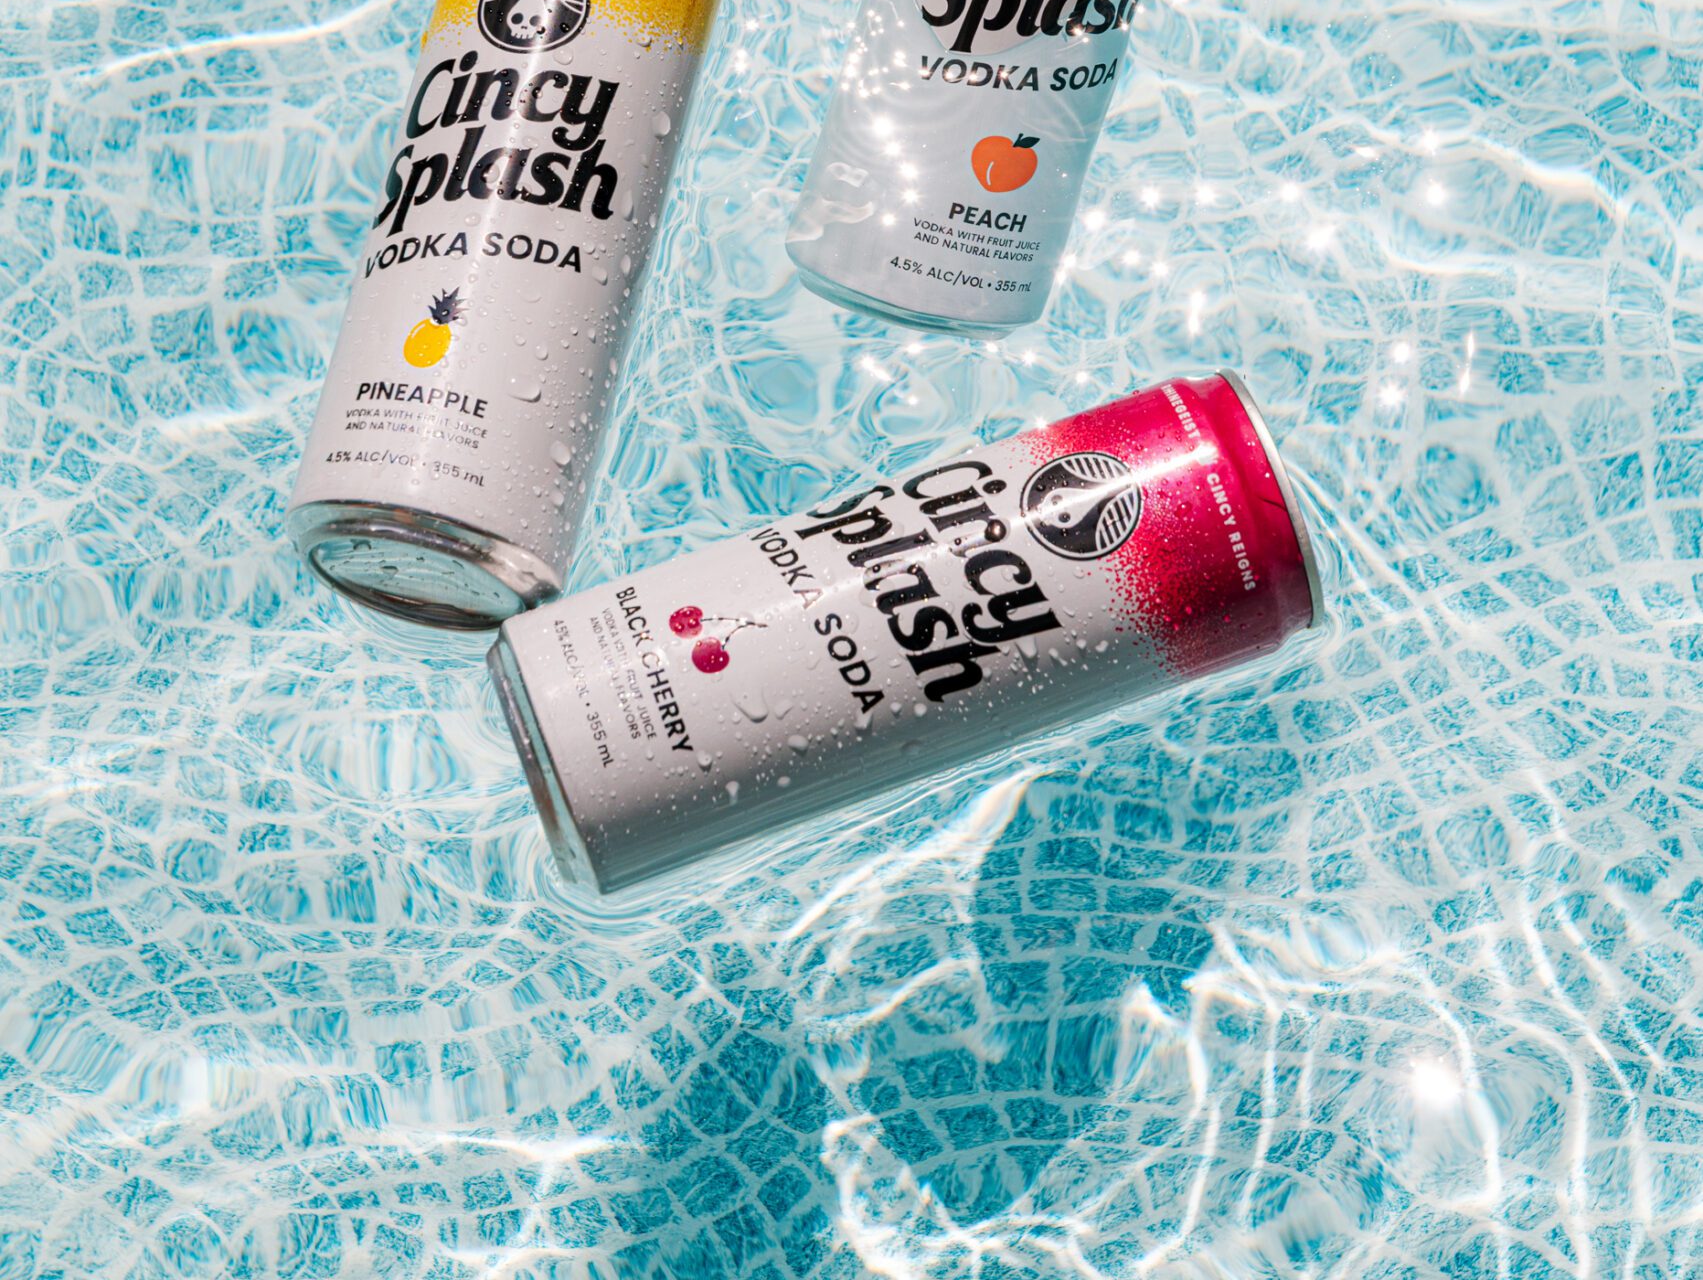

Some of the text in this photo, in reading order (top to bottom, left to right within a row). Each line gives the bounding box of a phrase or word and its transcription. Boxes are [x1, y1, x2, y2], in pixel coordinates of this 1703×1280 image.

[920, 55, 1118, 92] VODKA SODA
[406, 50, 620, 151] Cincy
[372, 124, 619, 238] Splash
[913, 217, 1041, 251] VODKA WITH FRUIT JUICE
[948, 202, 1027, 233] PEACH
[364, 231, 582, 279] VODKA SODA
[913, 231, 1034, 263] AND NATURAL FLAVORS
[889, 255, 923, 276] 4.5%
[926, 266, 985, 290] ALC/VOL
[995, 280, 1017, 293] 355
[346, 408, 380, 418] VODKA
[383, 409, 413, 420] WITH
[356, 381, 488, 418] PINEAPPLE
[345, 420, 367, 430] AND
[433, 461, 461, 478] 355
[1206, 472, 1237, 527] CINCY
[1227, 531, 1257, 592] REIGNS
[902, 461, 1063, 644] Cincy
[794, 485, 1001, 703] Splash
[590, 616, 603, 634] AND
[750, 528, 885, 714] VODKA SODA
[616, 586, 694, 752] BLACK CHERRY
[586, 712, 607, 741] 355
[637, 704, 657, 740] JUICE
